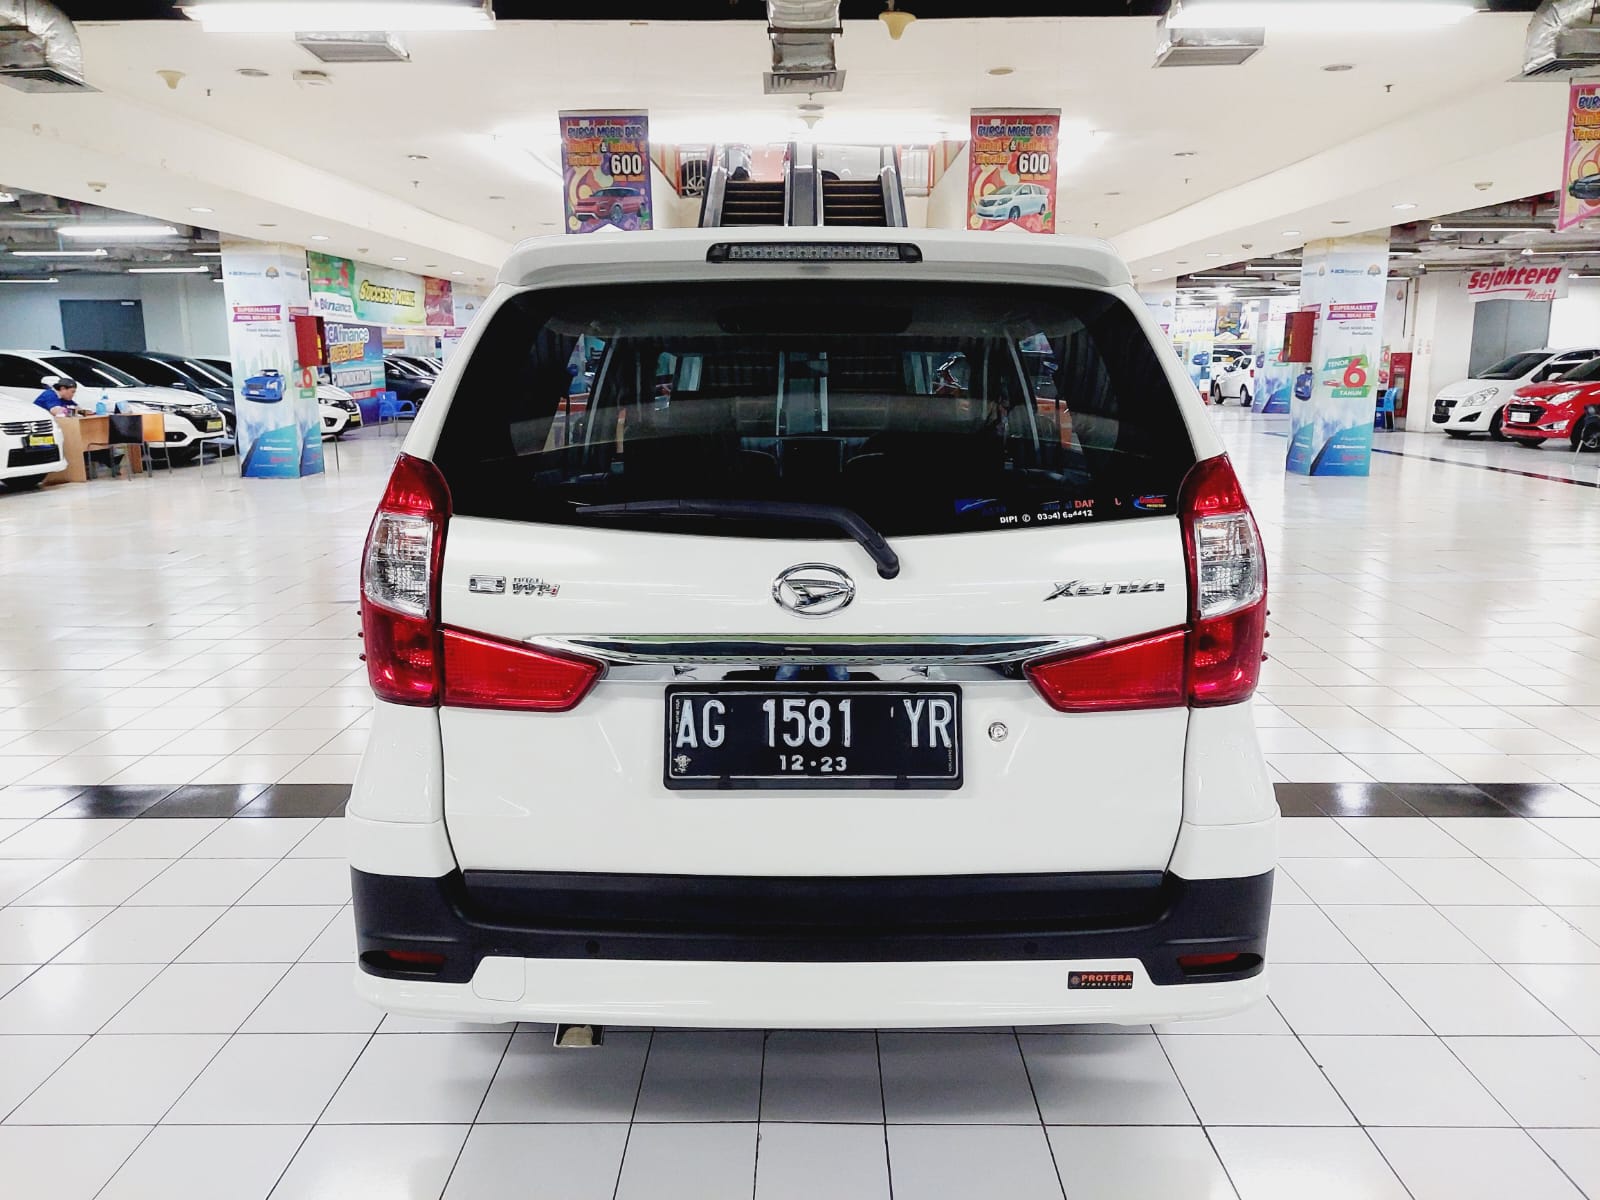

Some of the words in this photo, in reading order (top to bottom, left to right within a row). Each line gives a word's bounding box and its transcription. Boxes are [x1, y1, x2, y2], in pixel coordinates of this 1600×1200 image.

[611, 154, 642, 174] 600
[1019, 153, 1049, 173] 600
[1343, 357, 1366, 387] 6
[675, 699, 726, 748] AG
[763, 699, 852, 748] 1581
[903, 699, 953, 748] YR
